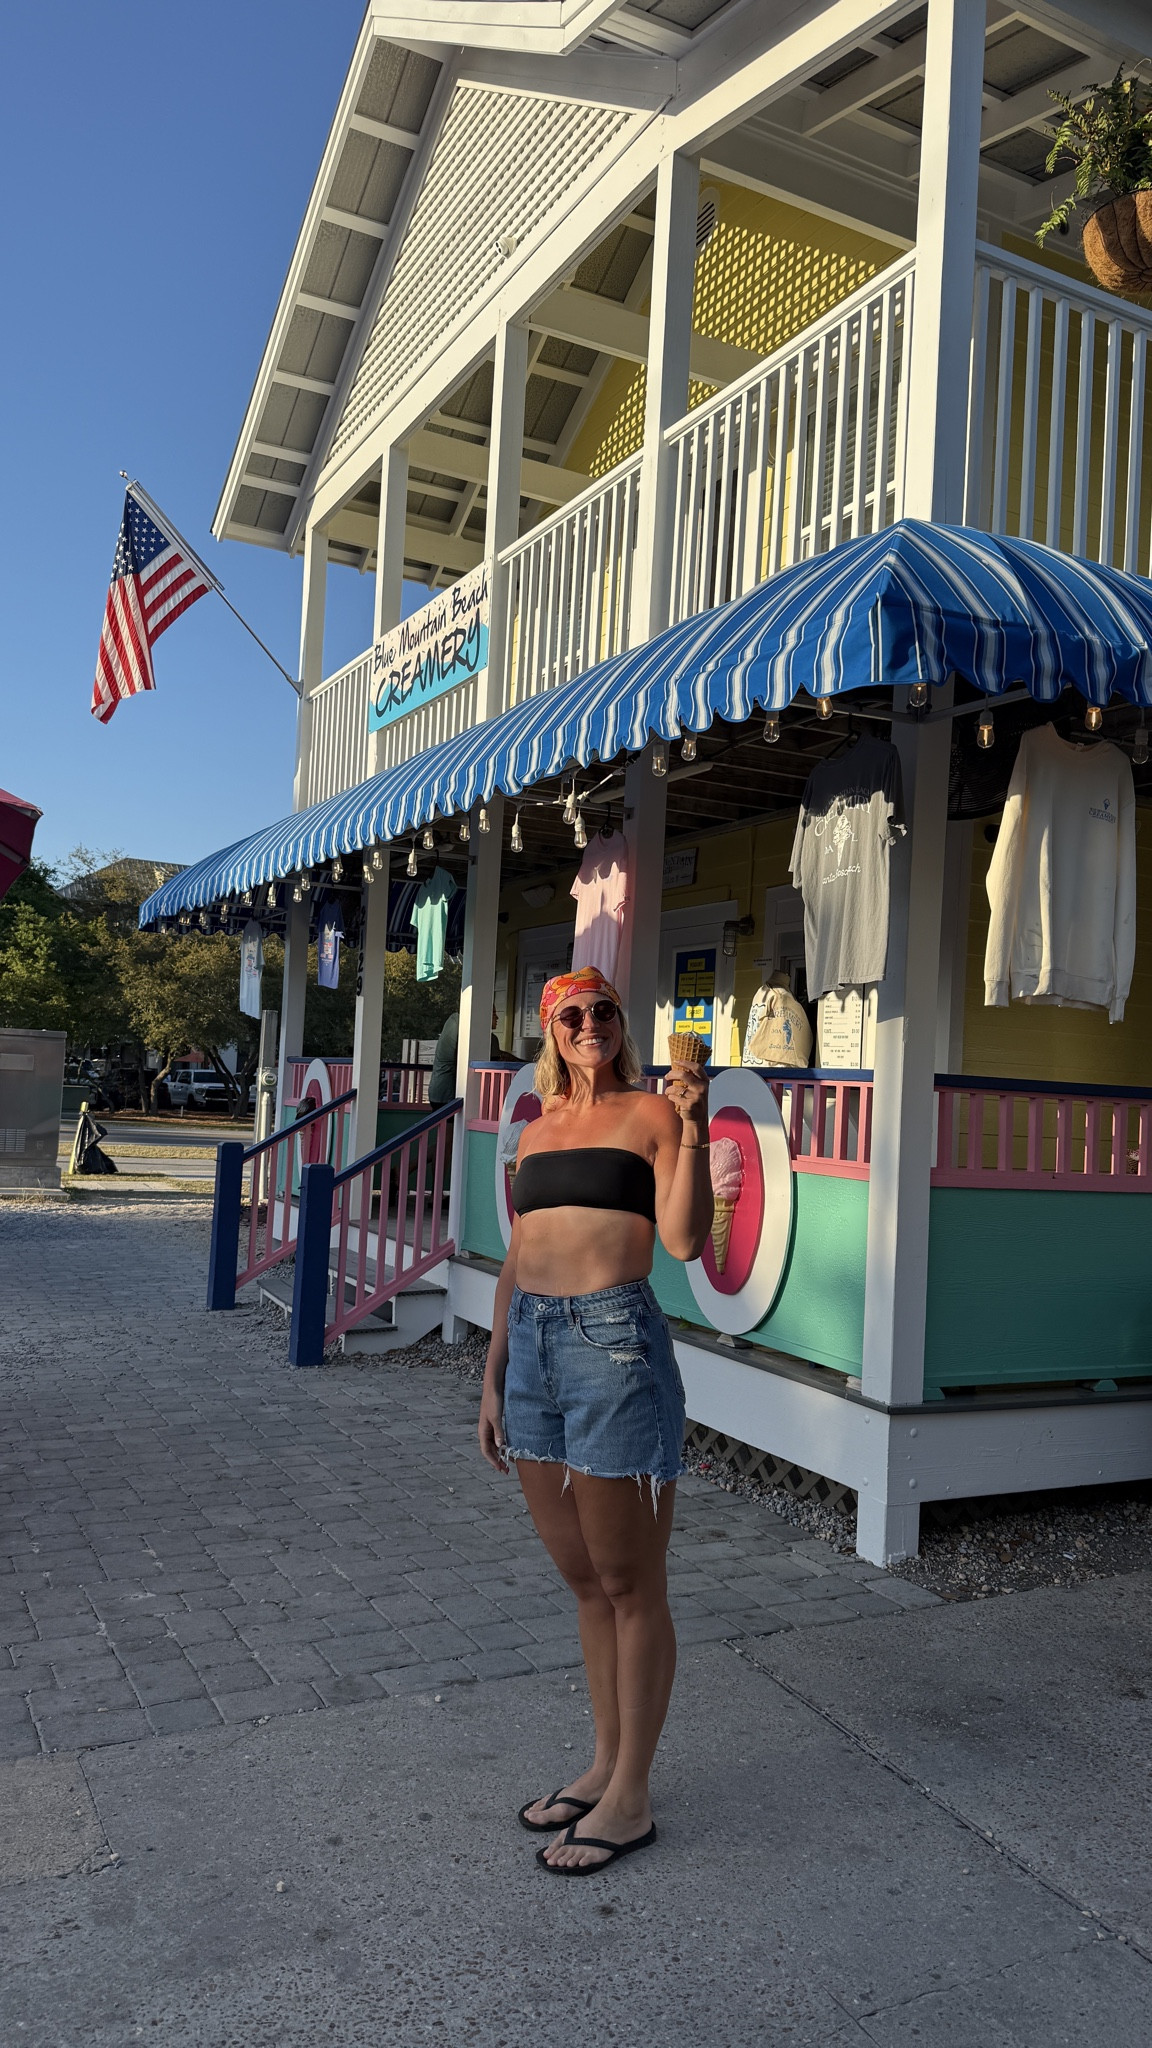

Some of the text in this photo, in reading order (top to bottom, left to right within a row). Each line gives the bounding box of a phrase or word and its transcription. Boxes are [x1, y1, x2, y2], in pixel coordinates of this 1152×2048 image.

[373, 568, 488, 675] Blue Mountain Beach
[375, 608, 482, 718] CREAMERY
